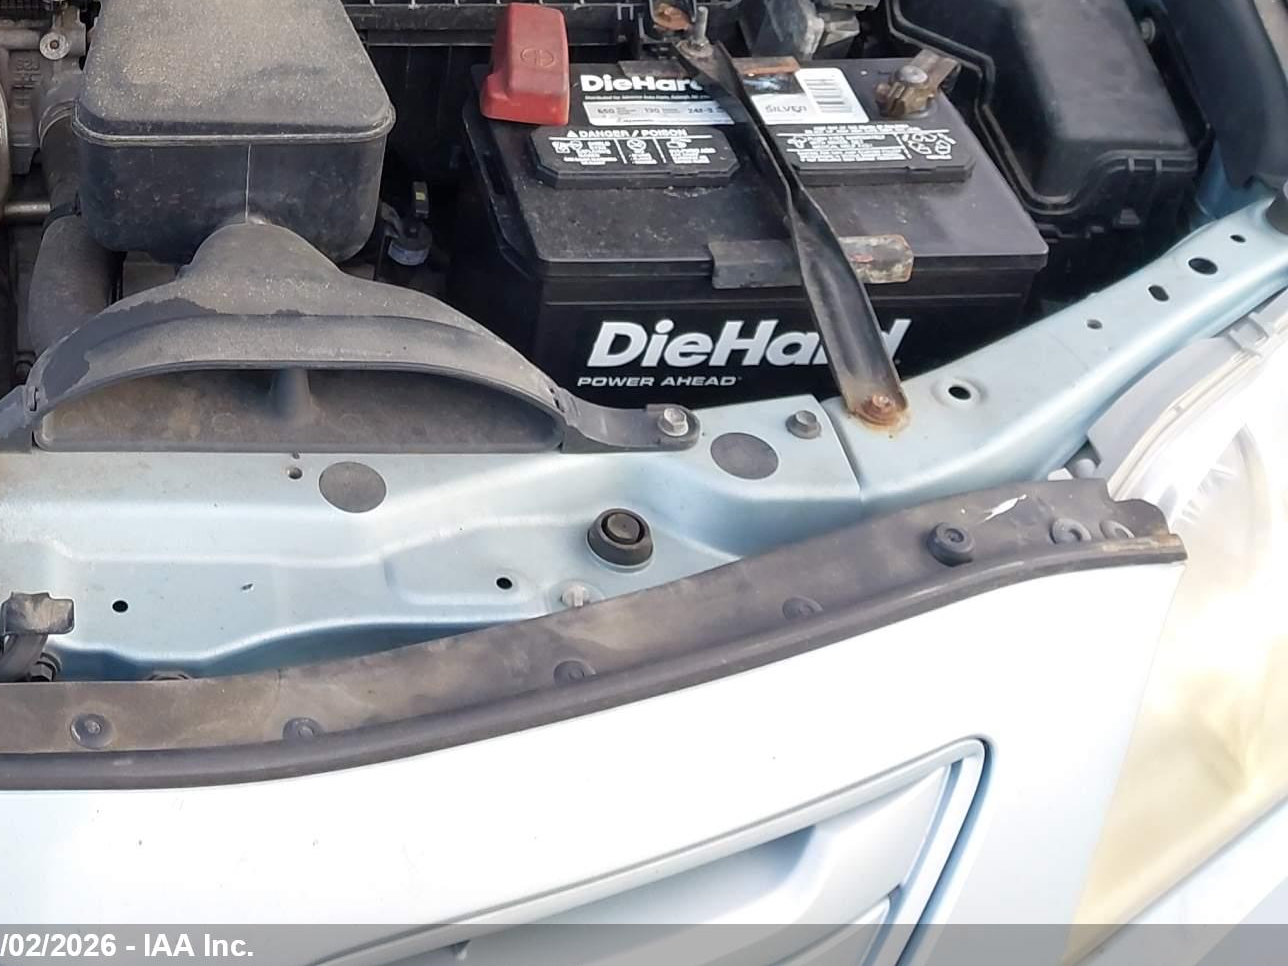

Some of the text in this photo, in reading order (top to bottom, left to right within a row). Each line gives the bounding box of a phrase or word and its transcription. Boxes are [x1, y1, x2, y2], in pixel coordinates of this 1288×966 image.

[579, 130, 630, 138] DANGER
[641, 129, 688, 138] POISON
[587, 318, 911, 367] DieHa
[577, 376, 738, 387] POWER AHEAD
